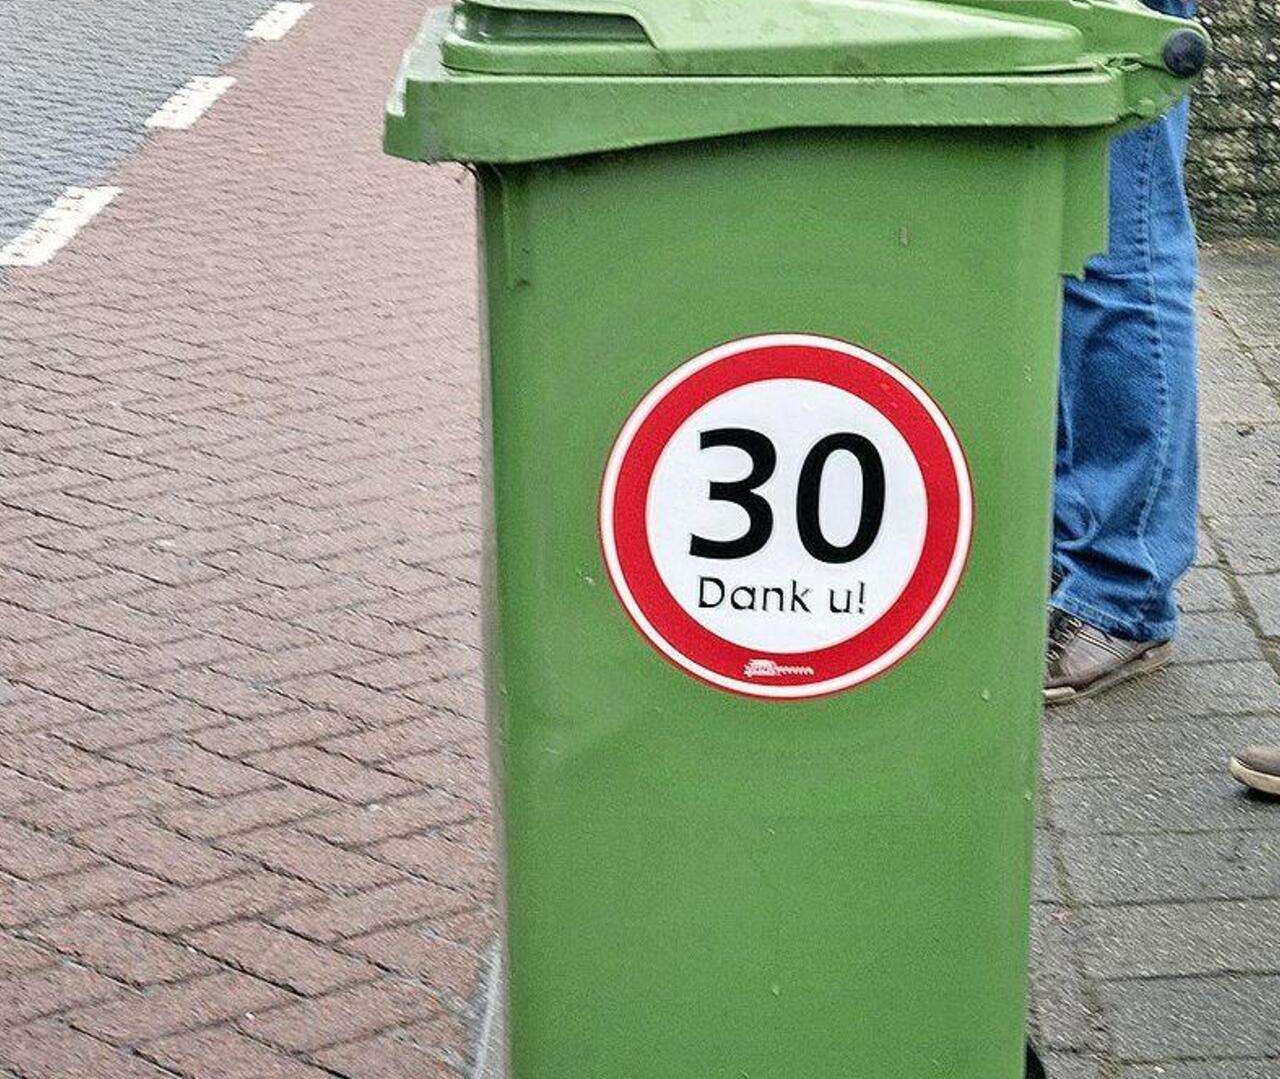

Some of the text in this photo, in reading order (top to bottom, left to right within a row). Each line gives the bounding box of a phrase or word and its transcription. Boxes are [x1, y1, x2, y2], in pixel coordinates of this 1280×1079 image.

[689, 428, 886, 564] 30
[698, 576, 867, 614] Dank u!
